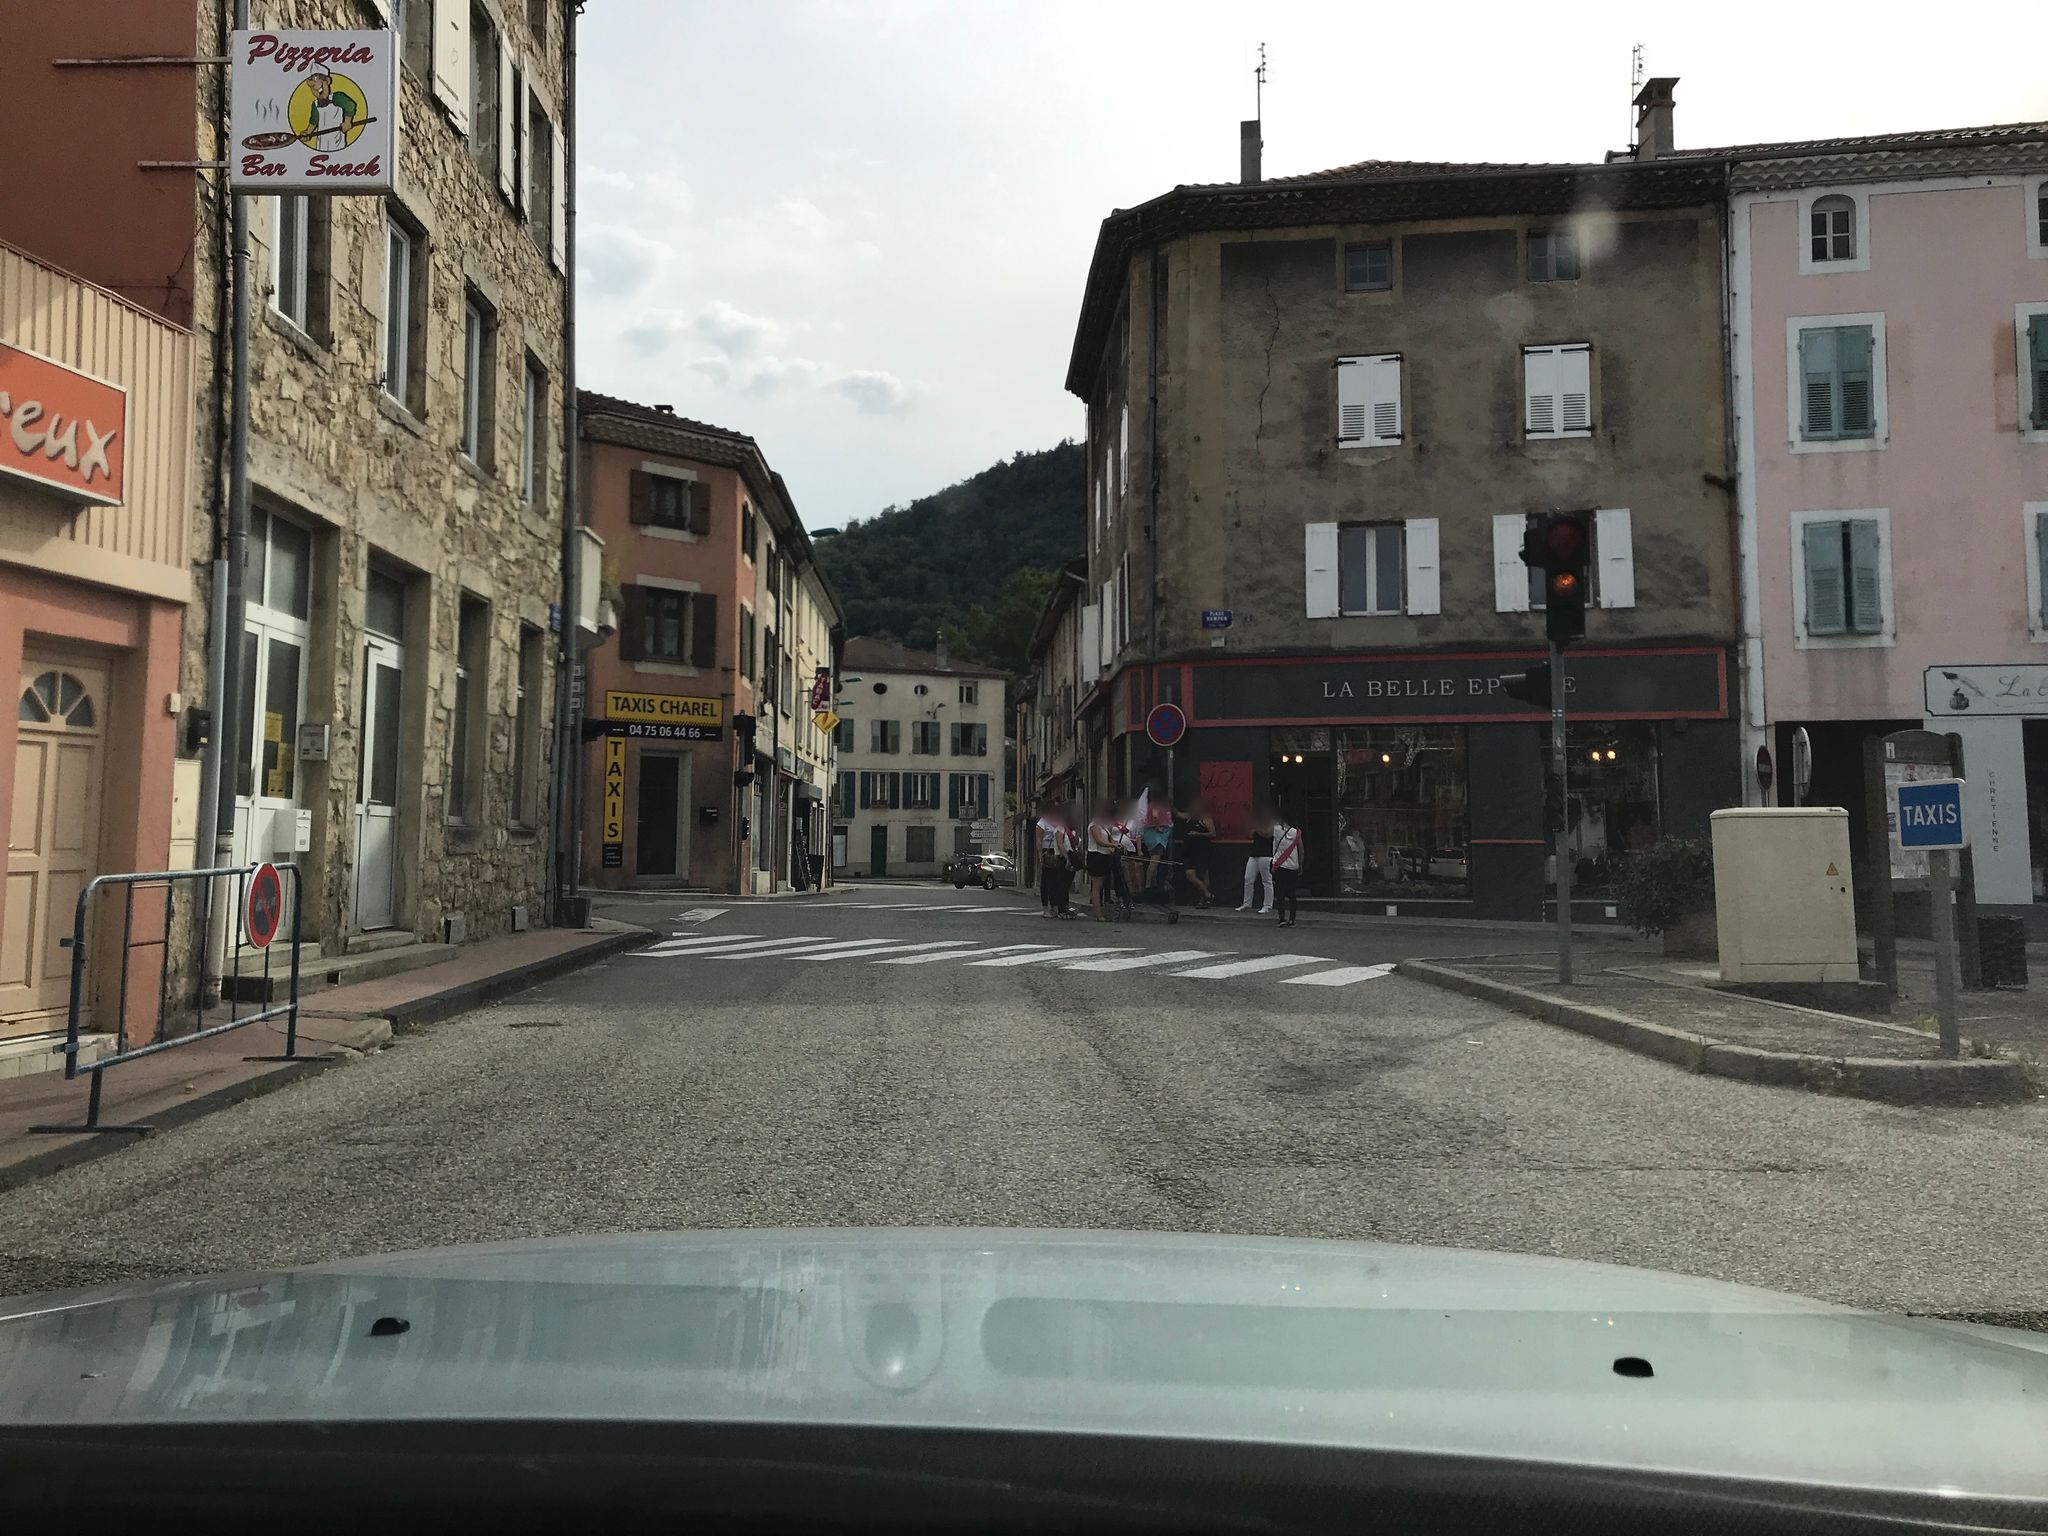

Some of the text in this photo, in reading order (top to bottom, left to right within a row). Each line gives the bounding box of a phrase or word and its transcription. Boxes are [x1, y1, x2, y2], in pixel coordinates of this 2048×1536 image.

[247, 34, 374, 72] Pizzeria
[241, 154, 381, 177] Bar Snack
[1322, 676, 1577, 698] LA BELLE EPE
[612, 696, 718, 718] TAXIS CHAREL
[629, 724, 700, 739] 04 75 06 44 66
[607, 741, 622, 838] TAXIS
[1903, 803, 1957, 826] TAXIS
